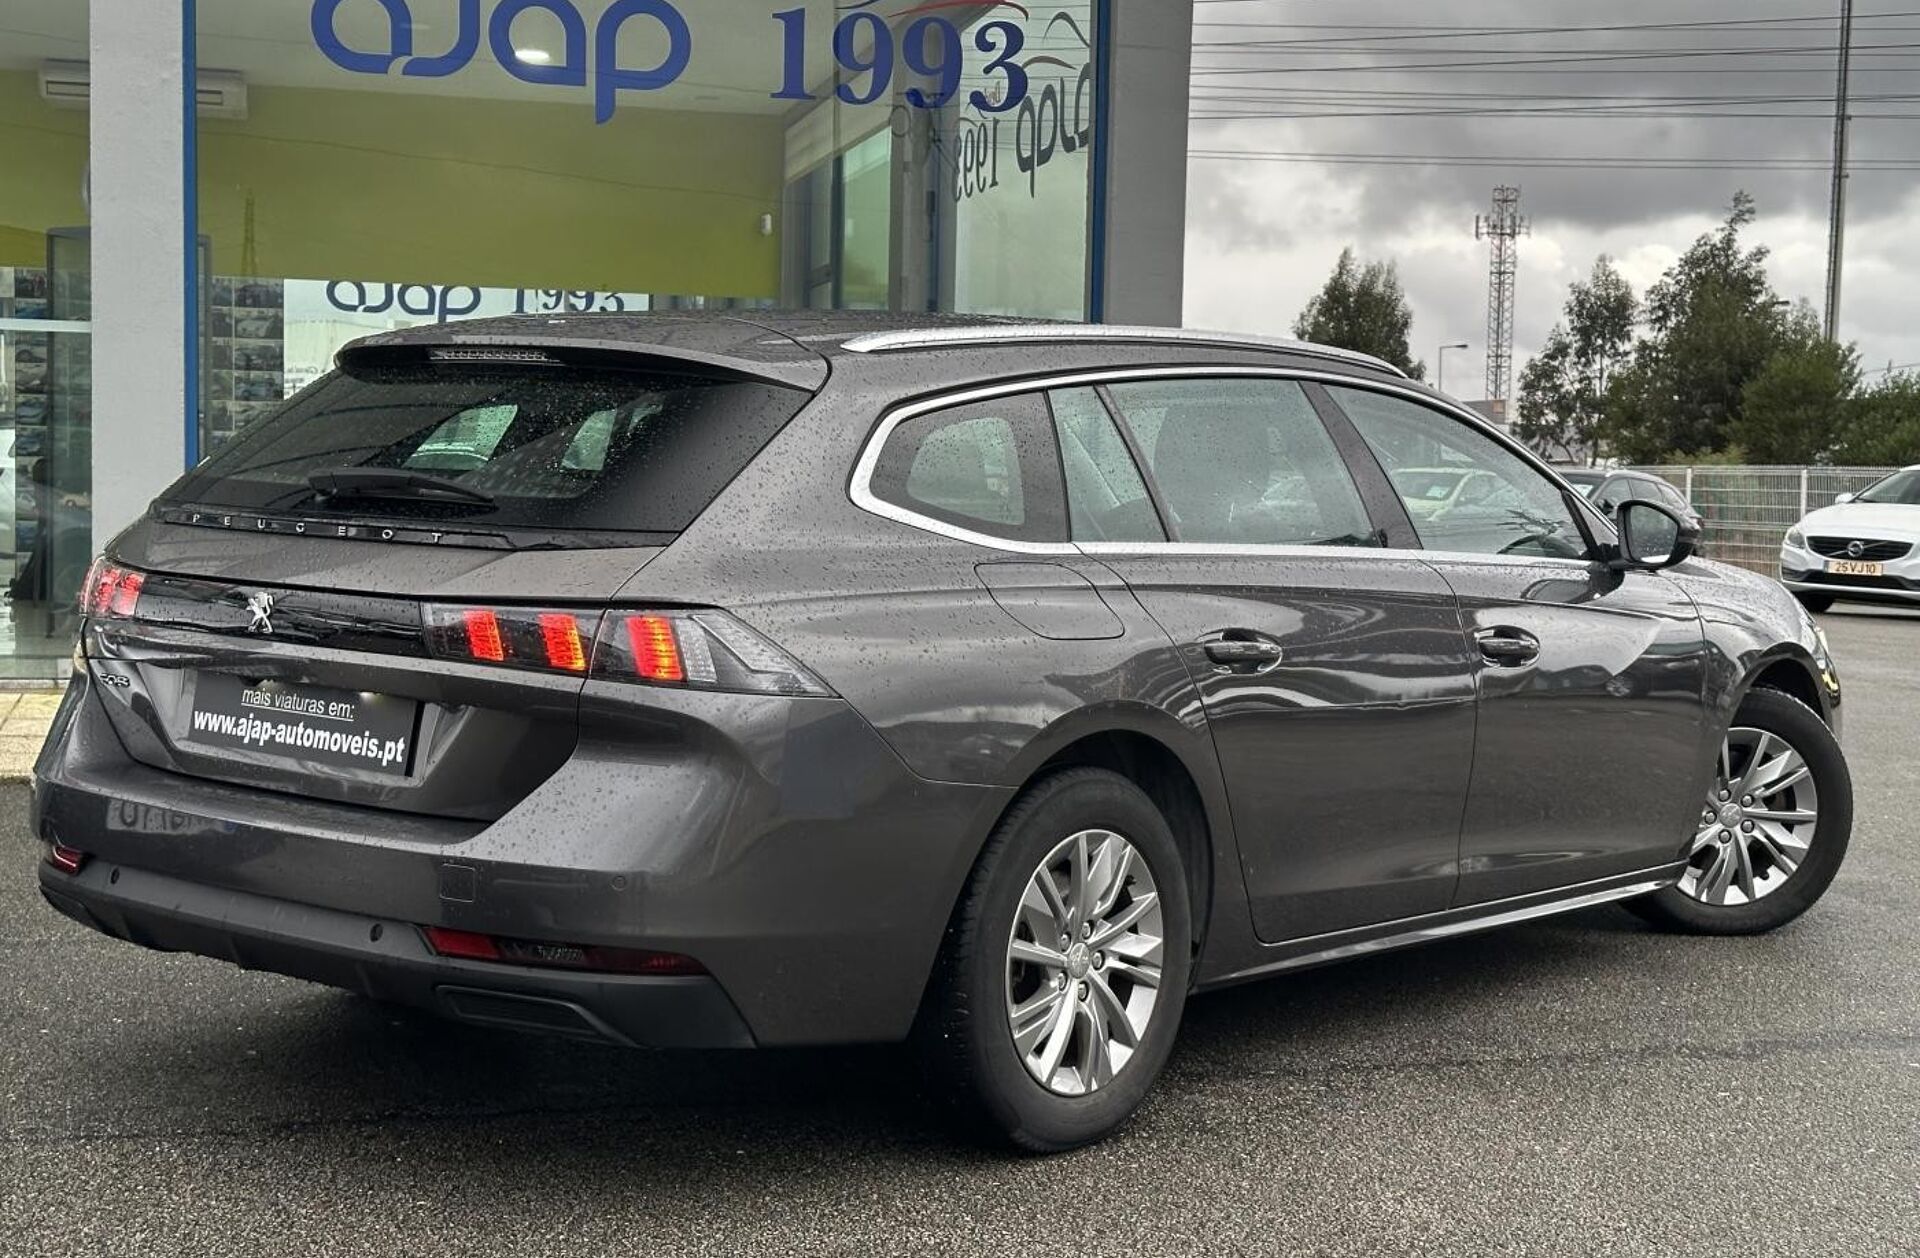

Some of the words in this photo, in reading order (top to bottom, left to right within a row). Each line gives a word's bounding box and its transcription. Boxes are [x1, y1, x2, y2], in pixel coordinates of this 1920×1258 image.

[769, 7, 1028, 112] 1993
[192, 513, 442, 543] PEUGEOT
[241, 688, 271, 707] mais
[274, 692, 325, 714] viaturas
[328, 701, 355, 719] em:
[194, 711, 405, 766] www.ajap-automoveis.pt
